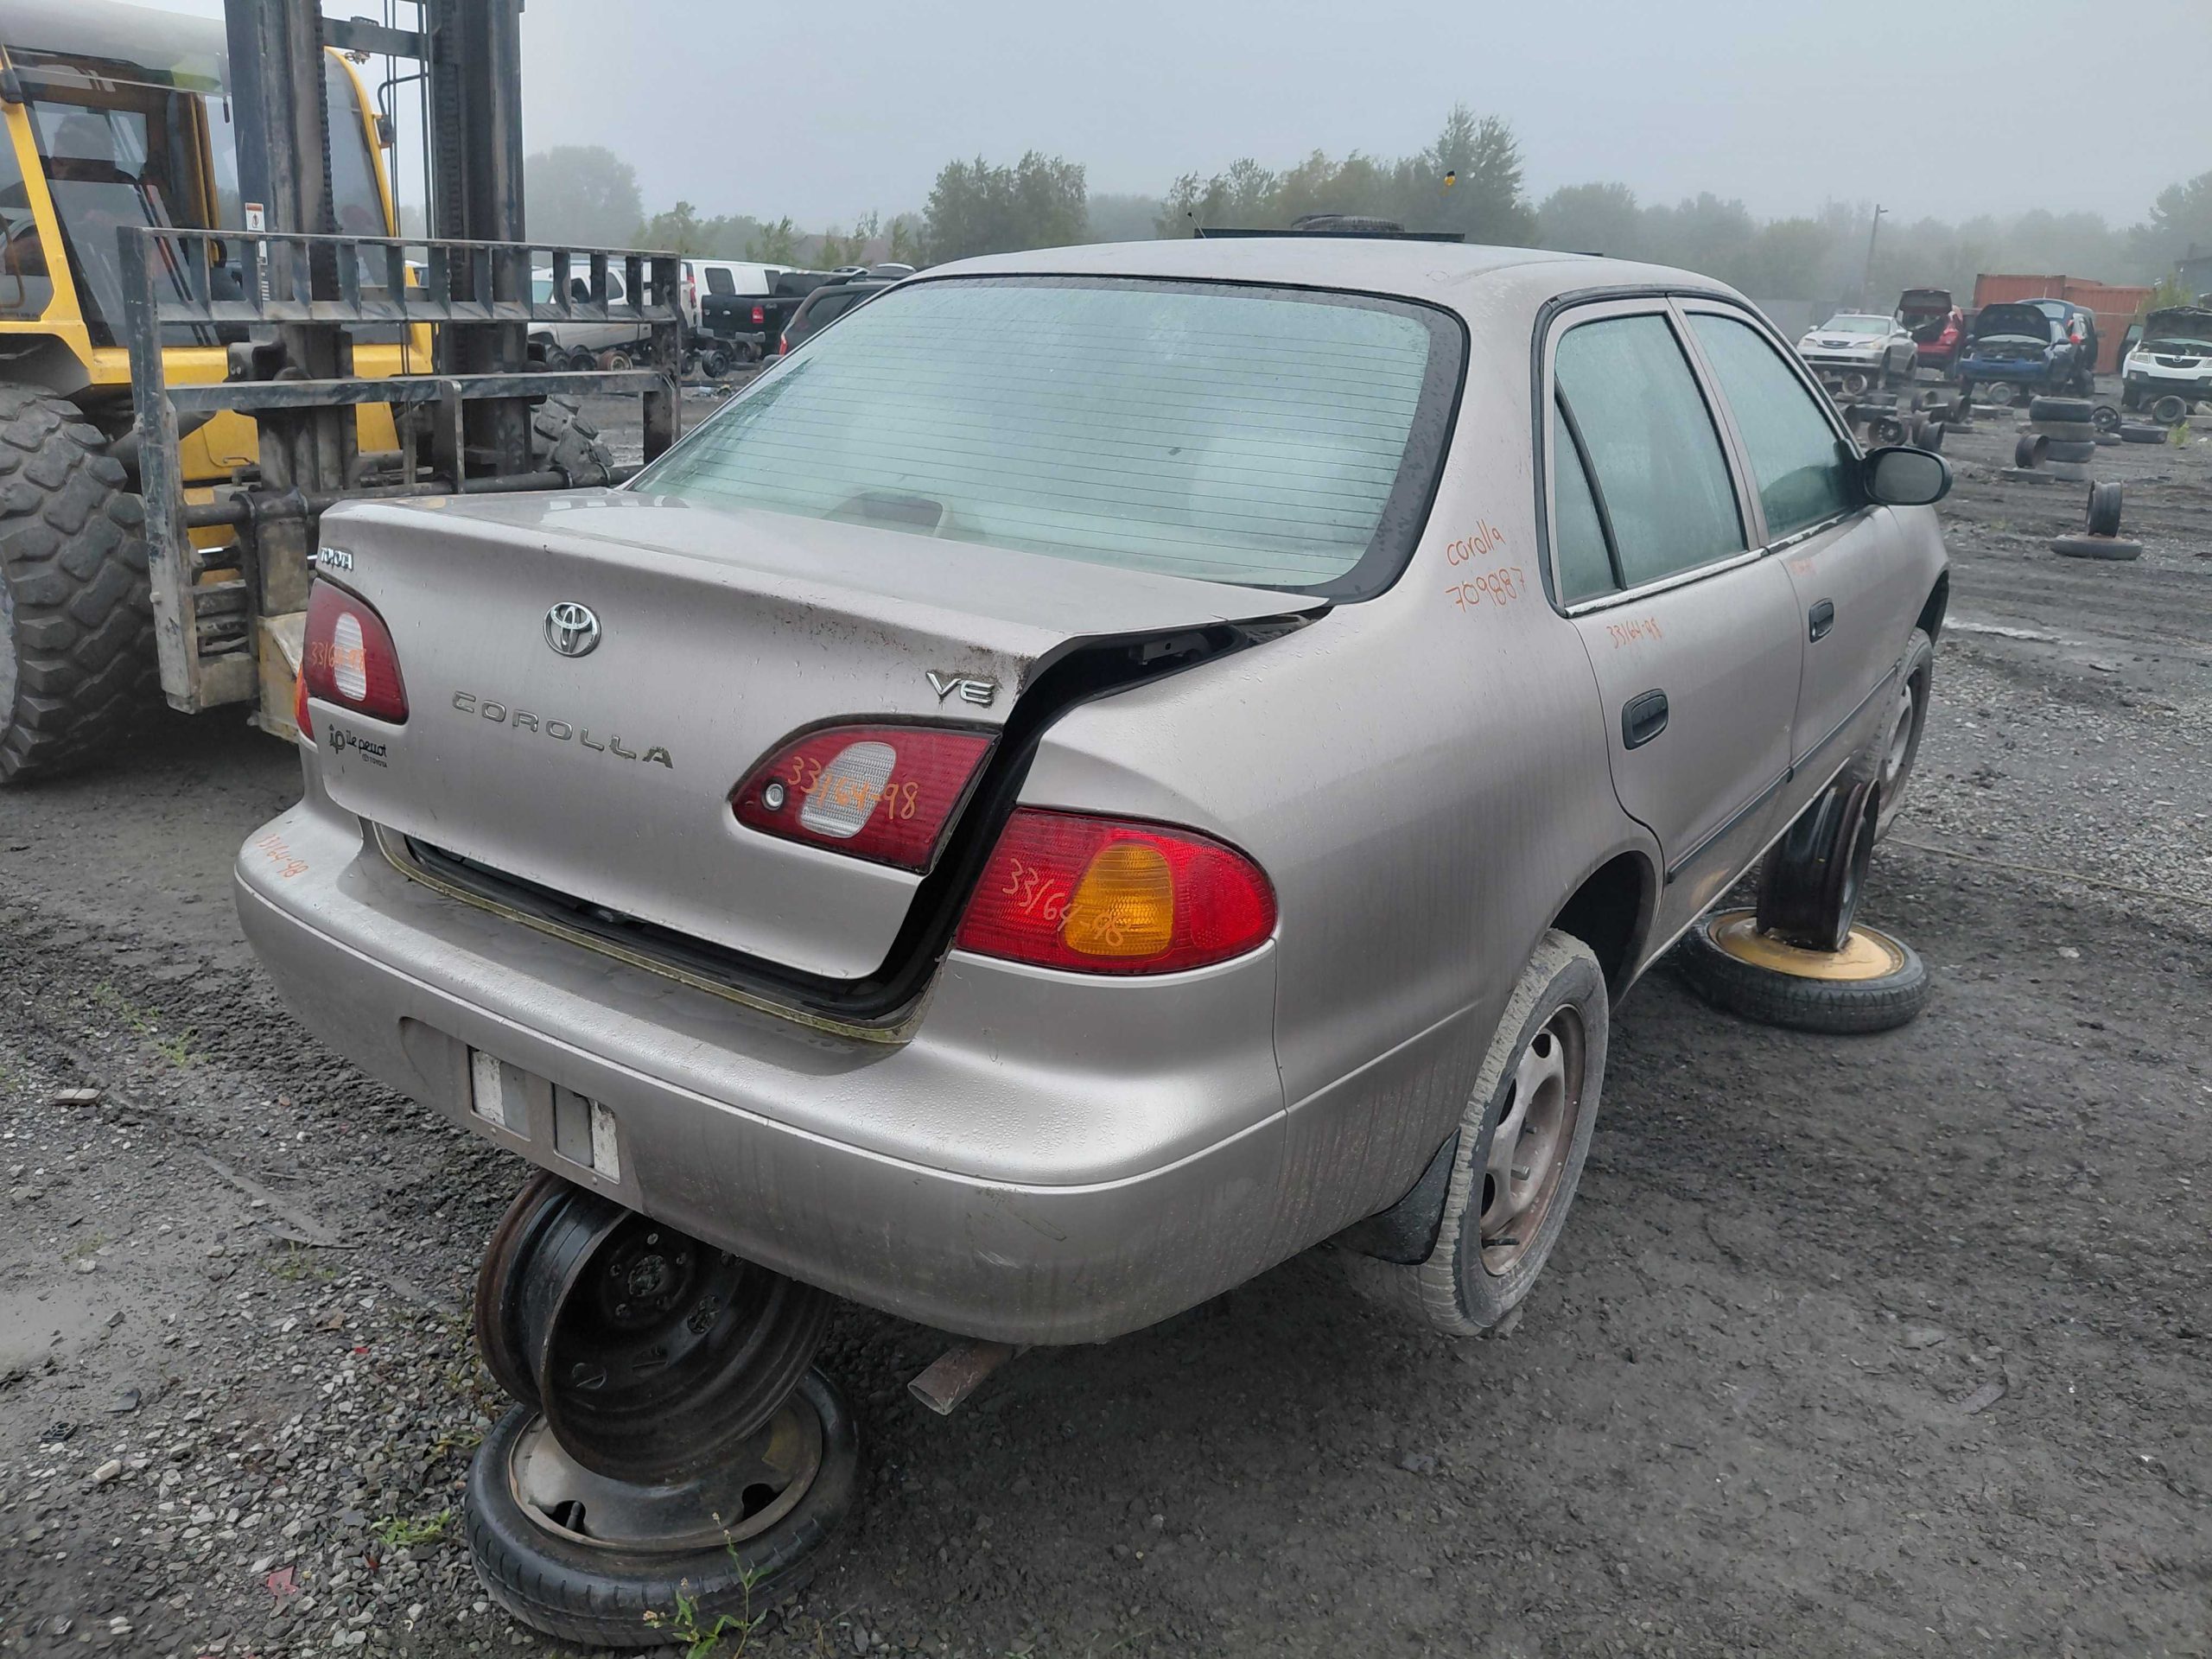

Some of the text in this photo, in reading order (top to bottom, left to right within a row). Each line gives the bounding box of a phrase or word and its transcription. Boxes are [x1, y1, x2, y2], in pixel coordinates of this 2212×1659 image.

[321, 546, 353, 570] TOYOTA
[925, 671, 995, 705] VE
[453, 691, 674, 769] COROLLA
[369, 756, 388, 768] TOYOTA
[787, 756, 919, 820] 33164-98
[1002, 858, 1132, 947] 33164-98
